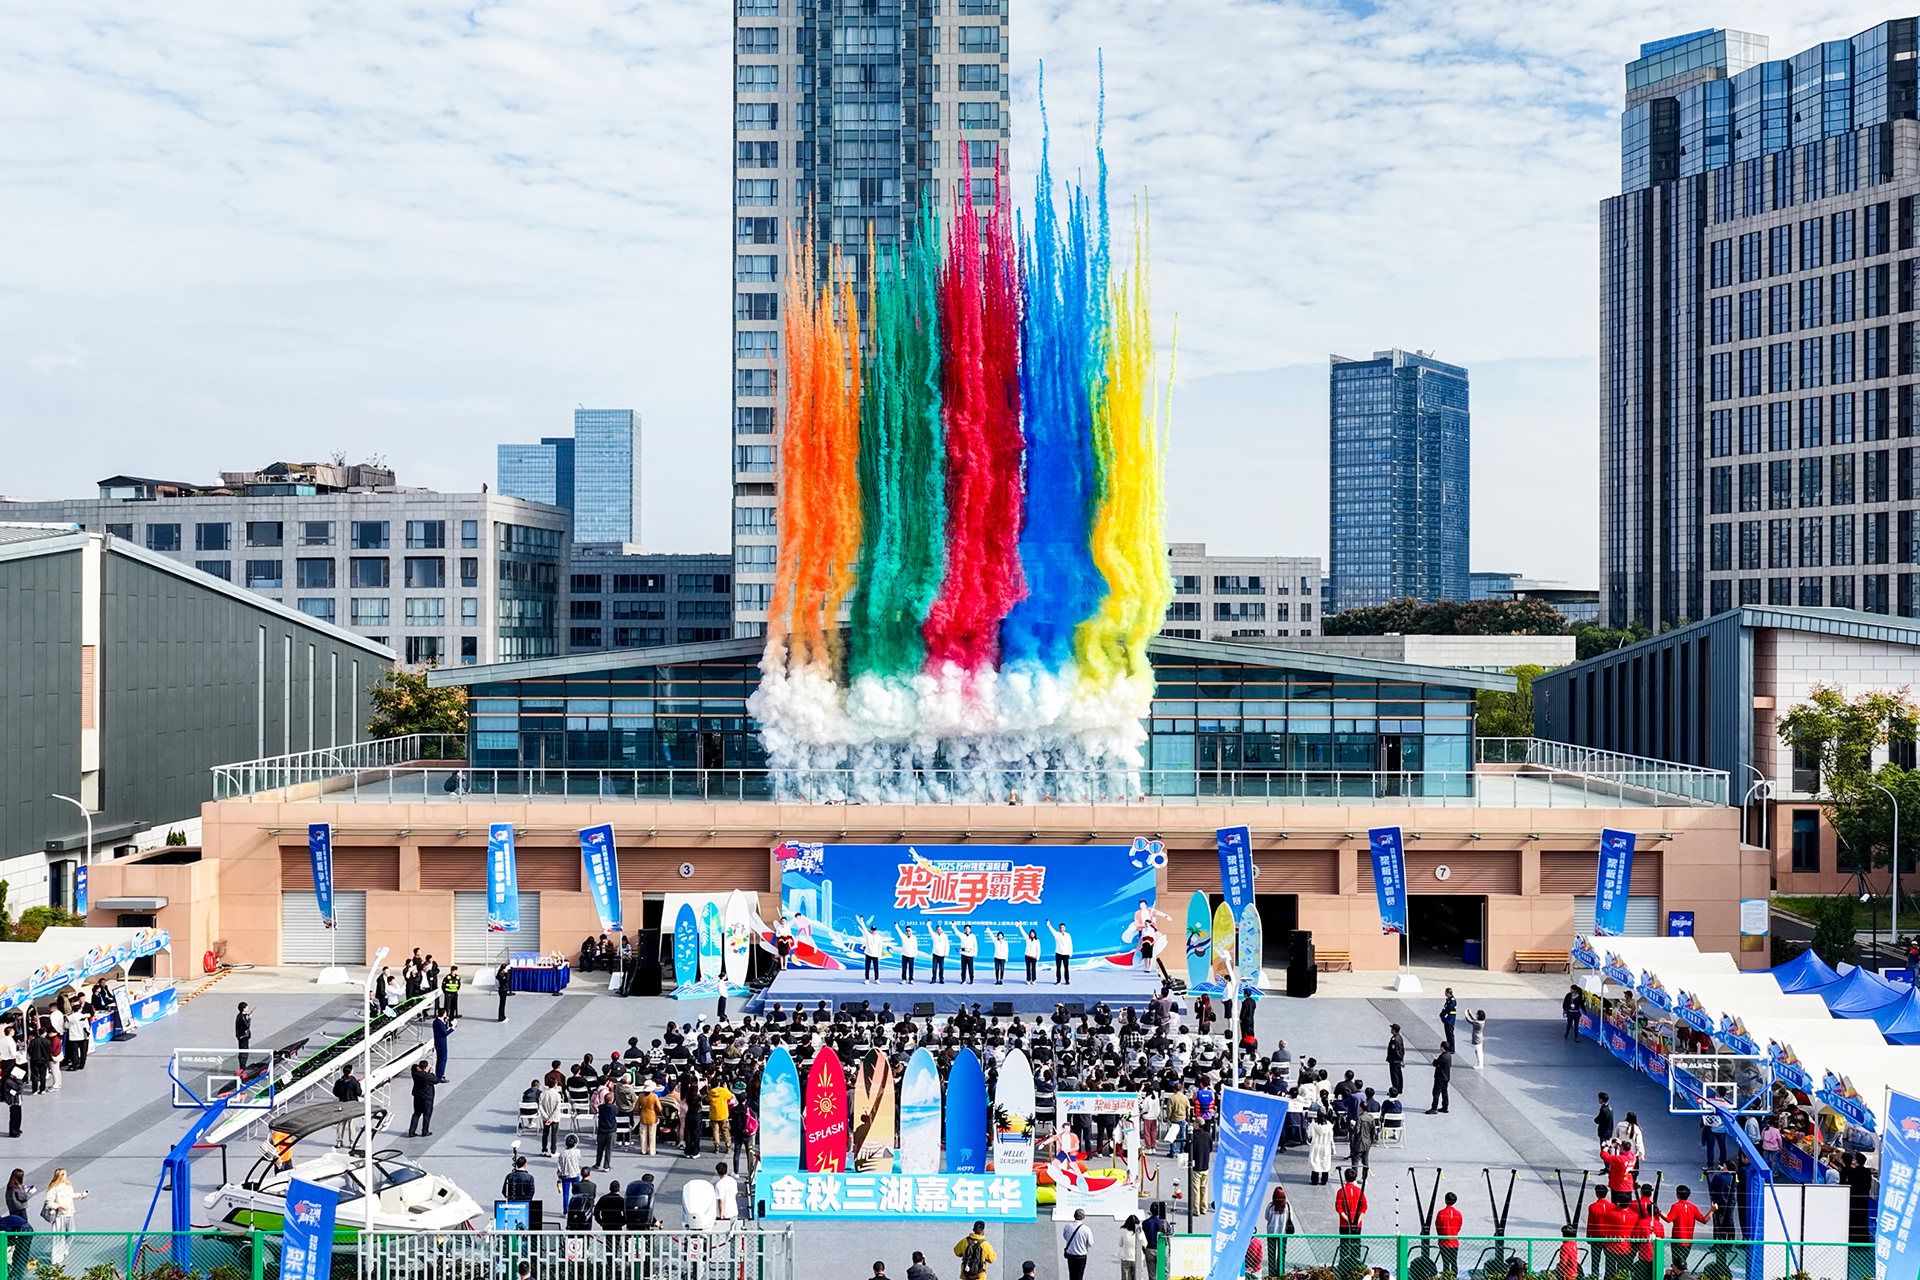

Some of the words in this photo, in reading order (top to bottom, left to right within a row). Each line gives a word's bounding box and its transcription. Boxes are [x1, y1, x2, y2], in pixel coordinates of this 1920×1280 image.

[683, 864, 691, 875] 3
[1439, 867, 1447, 877] 7
[895, 865, 1044, 912] 桨板争霸赛
[808, 1122, 845, 1143] SPLASH
[1002, 1150, 1025, 1158] HELLO
[770, 1174, 1022, 1213] 金秋三湖嘉年华
